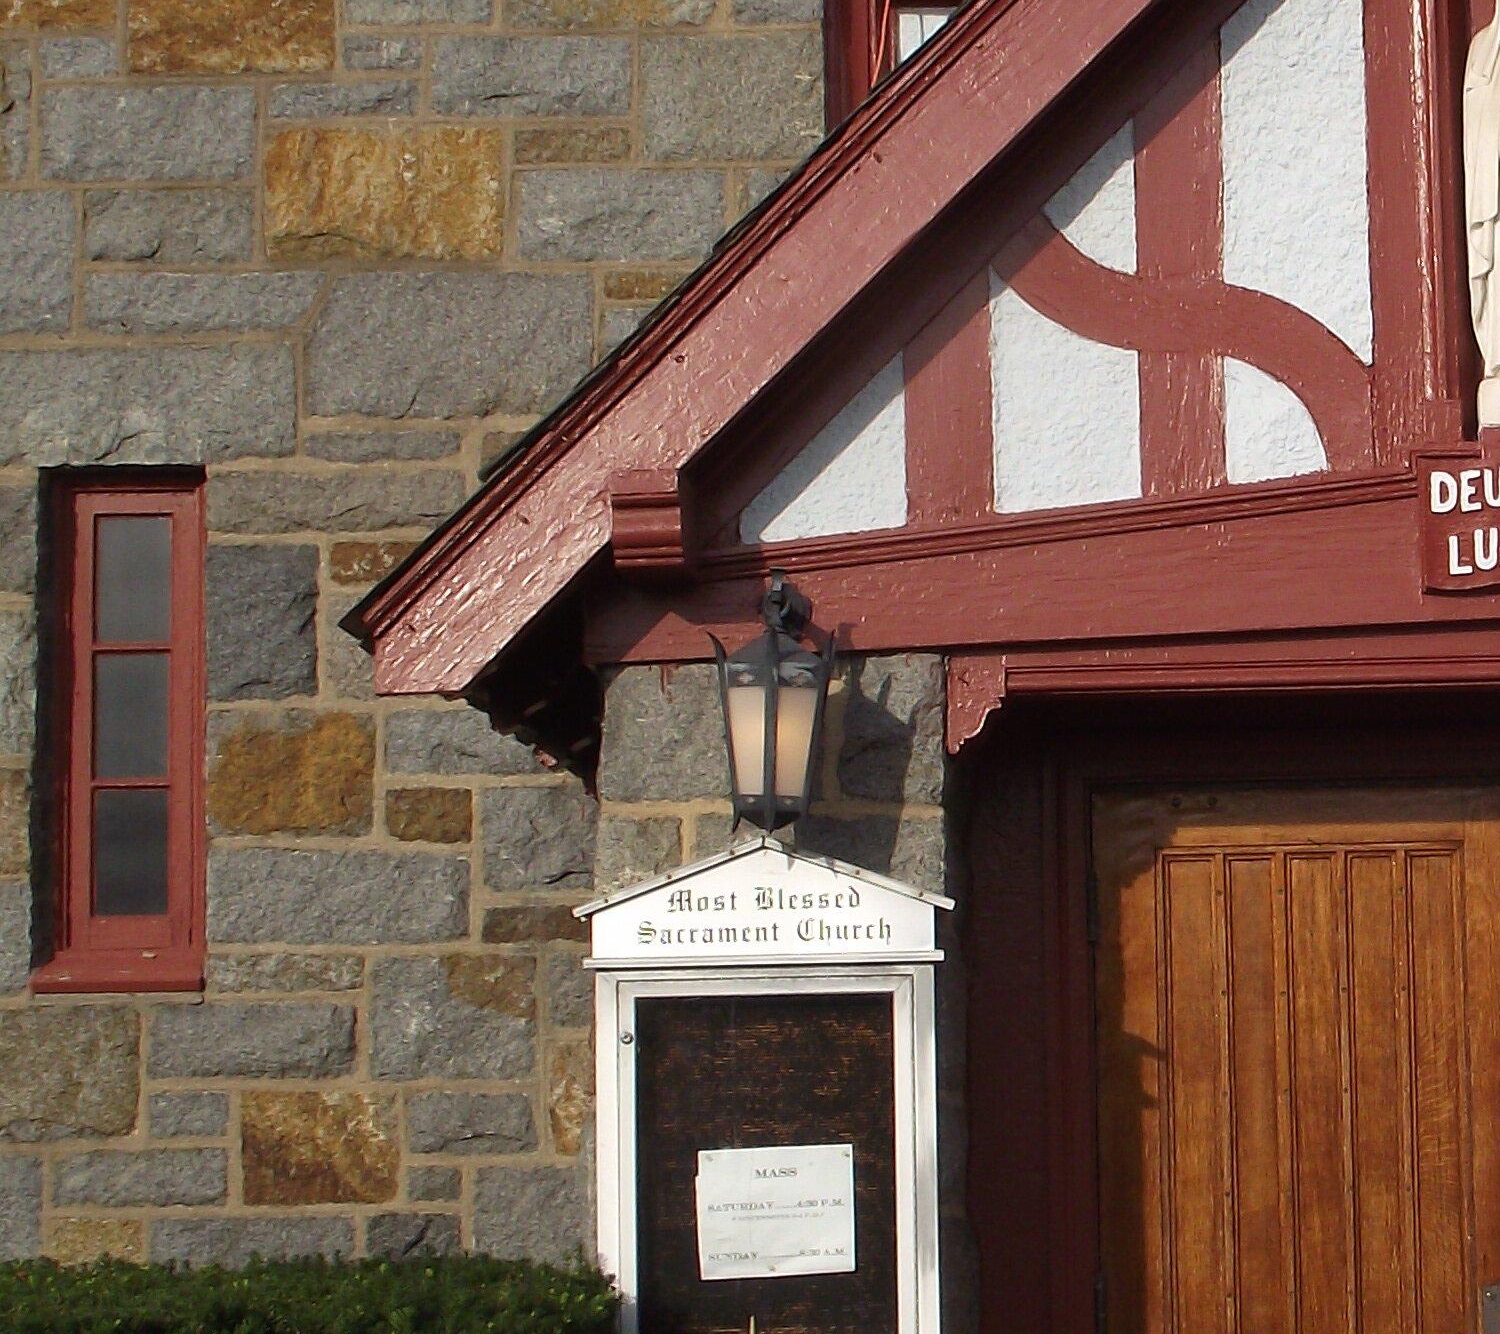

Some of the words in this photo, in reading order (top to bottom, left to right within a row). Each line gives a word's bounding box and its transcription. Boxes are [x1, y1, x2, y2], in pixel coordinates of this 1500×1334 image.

[667, 889, 737, 913] Most
[755, 886, 861, 910] Blessed
[637, 921, 780, 945] Sacrament
[797, 917, 892, 945] Church
[754, 1168, 798, 1179] MASS
